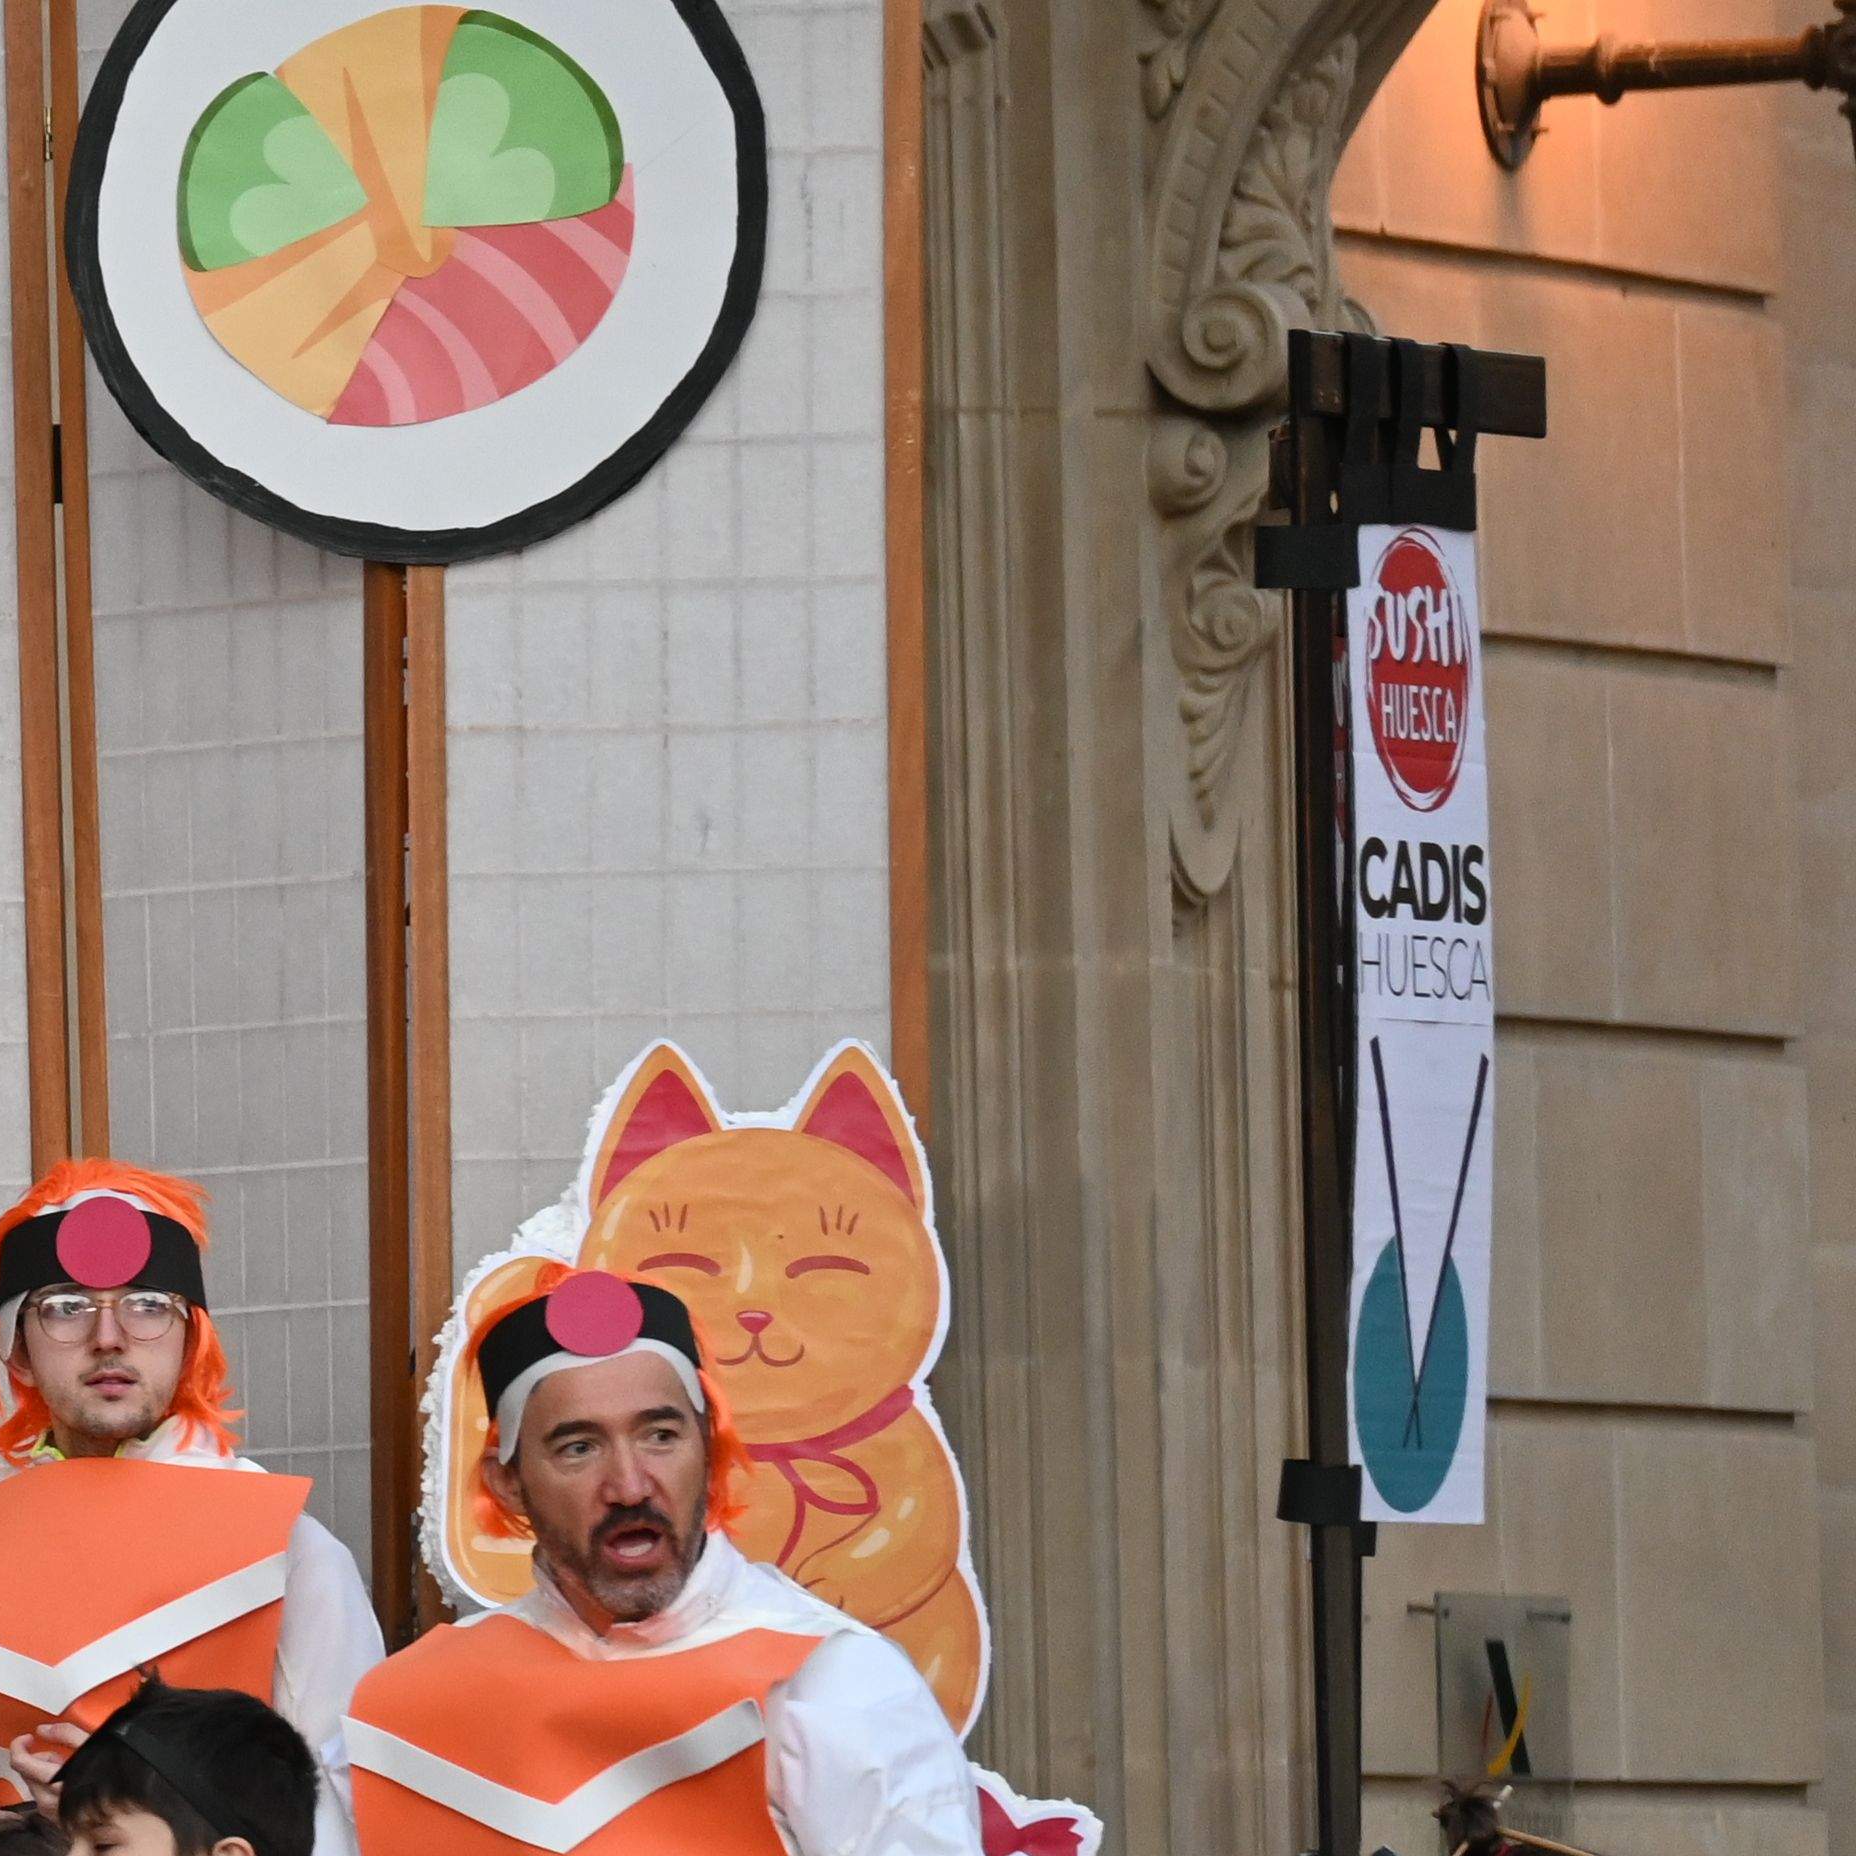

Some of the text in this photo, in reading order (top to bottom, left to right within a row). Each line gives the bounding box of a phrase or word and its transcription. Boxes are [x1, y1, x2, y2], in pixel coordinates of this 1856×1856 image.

[1366, 584, 1465, 667] SUSHI
[1381, 682, 1457, 743] HUESCA
[1359, 836, 1487, 925] CADIS
[1359, 932, 1490, 1002] HUESCA
